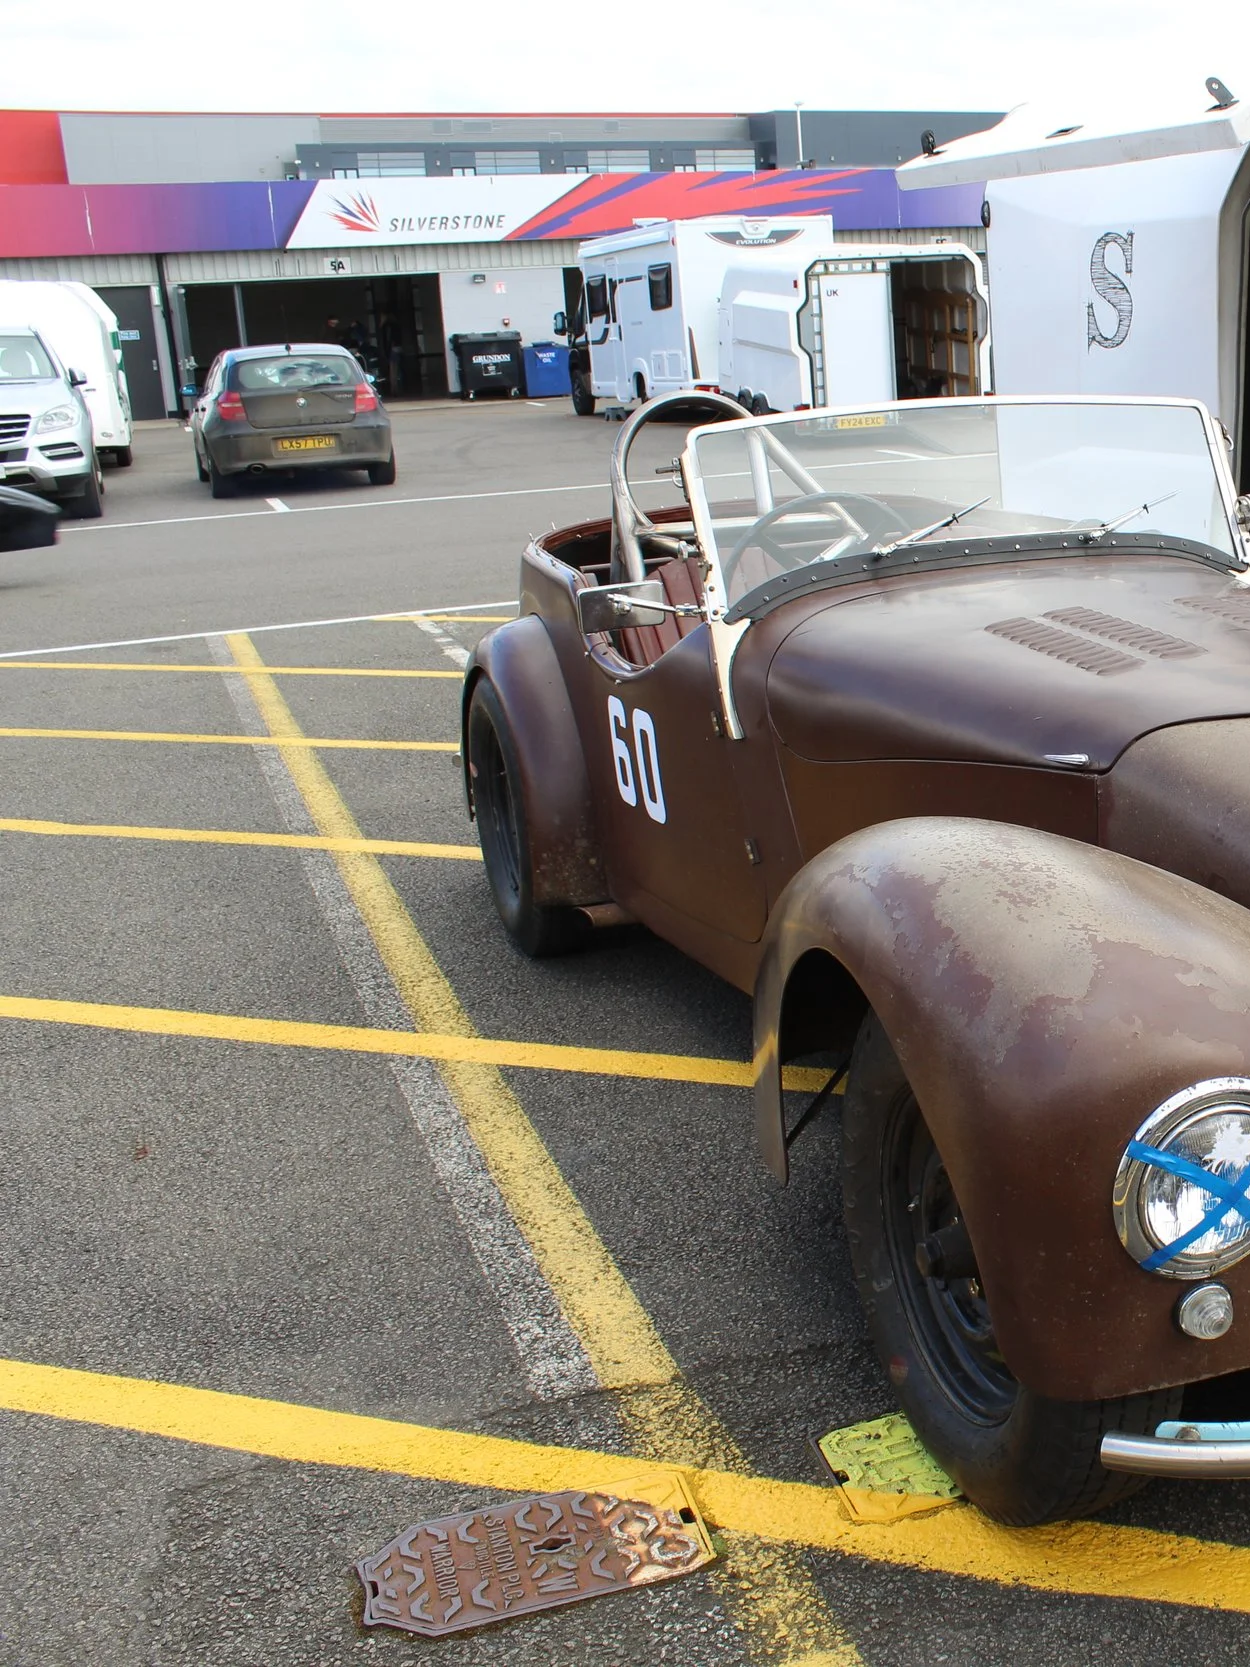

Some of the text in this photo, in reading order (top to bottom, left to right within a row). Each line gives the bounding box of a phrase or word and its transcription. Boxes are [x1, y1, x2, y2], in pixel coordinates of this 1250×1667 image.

[389, 214, 506, 233] SILVERSTONE
[736, 238, 777, 246] EVOLUTION
[330, 260, 346, 271] 5A
[826, 288, 839, 298] UK
[1087, 231, 1134, 353] S
[472, 354, 511, 363] GRUNDON
[840, 417, 863, 427] FY24
[280, 437, 331, 450] LX57 TPU
[607, 694, 667, 825] 60
[484, 1517, 525, 1600] STANTON PLC
[430, 1541, 461, 1600] WARRIOR
